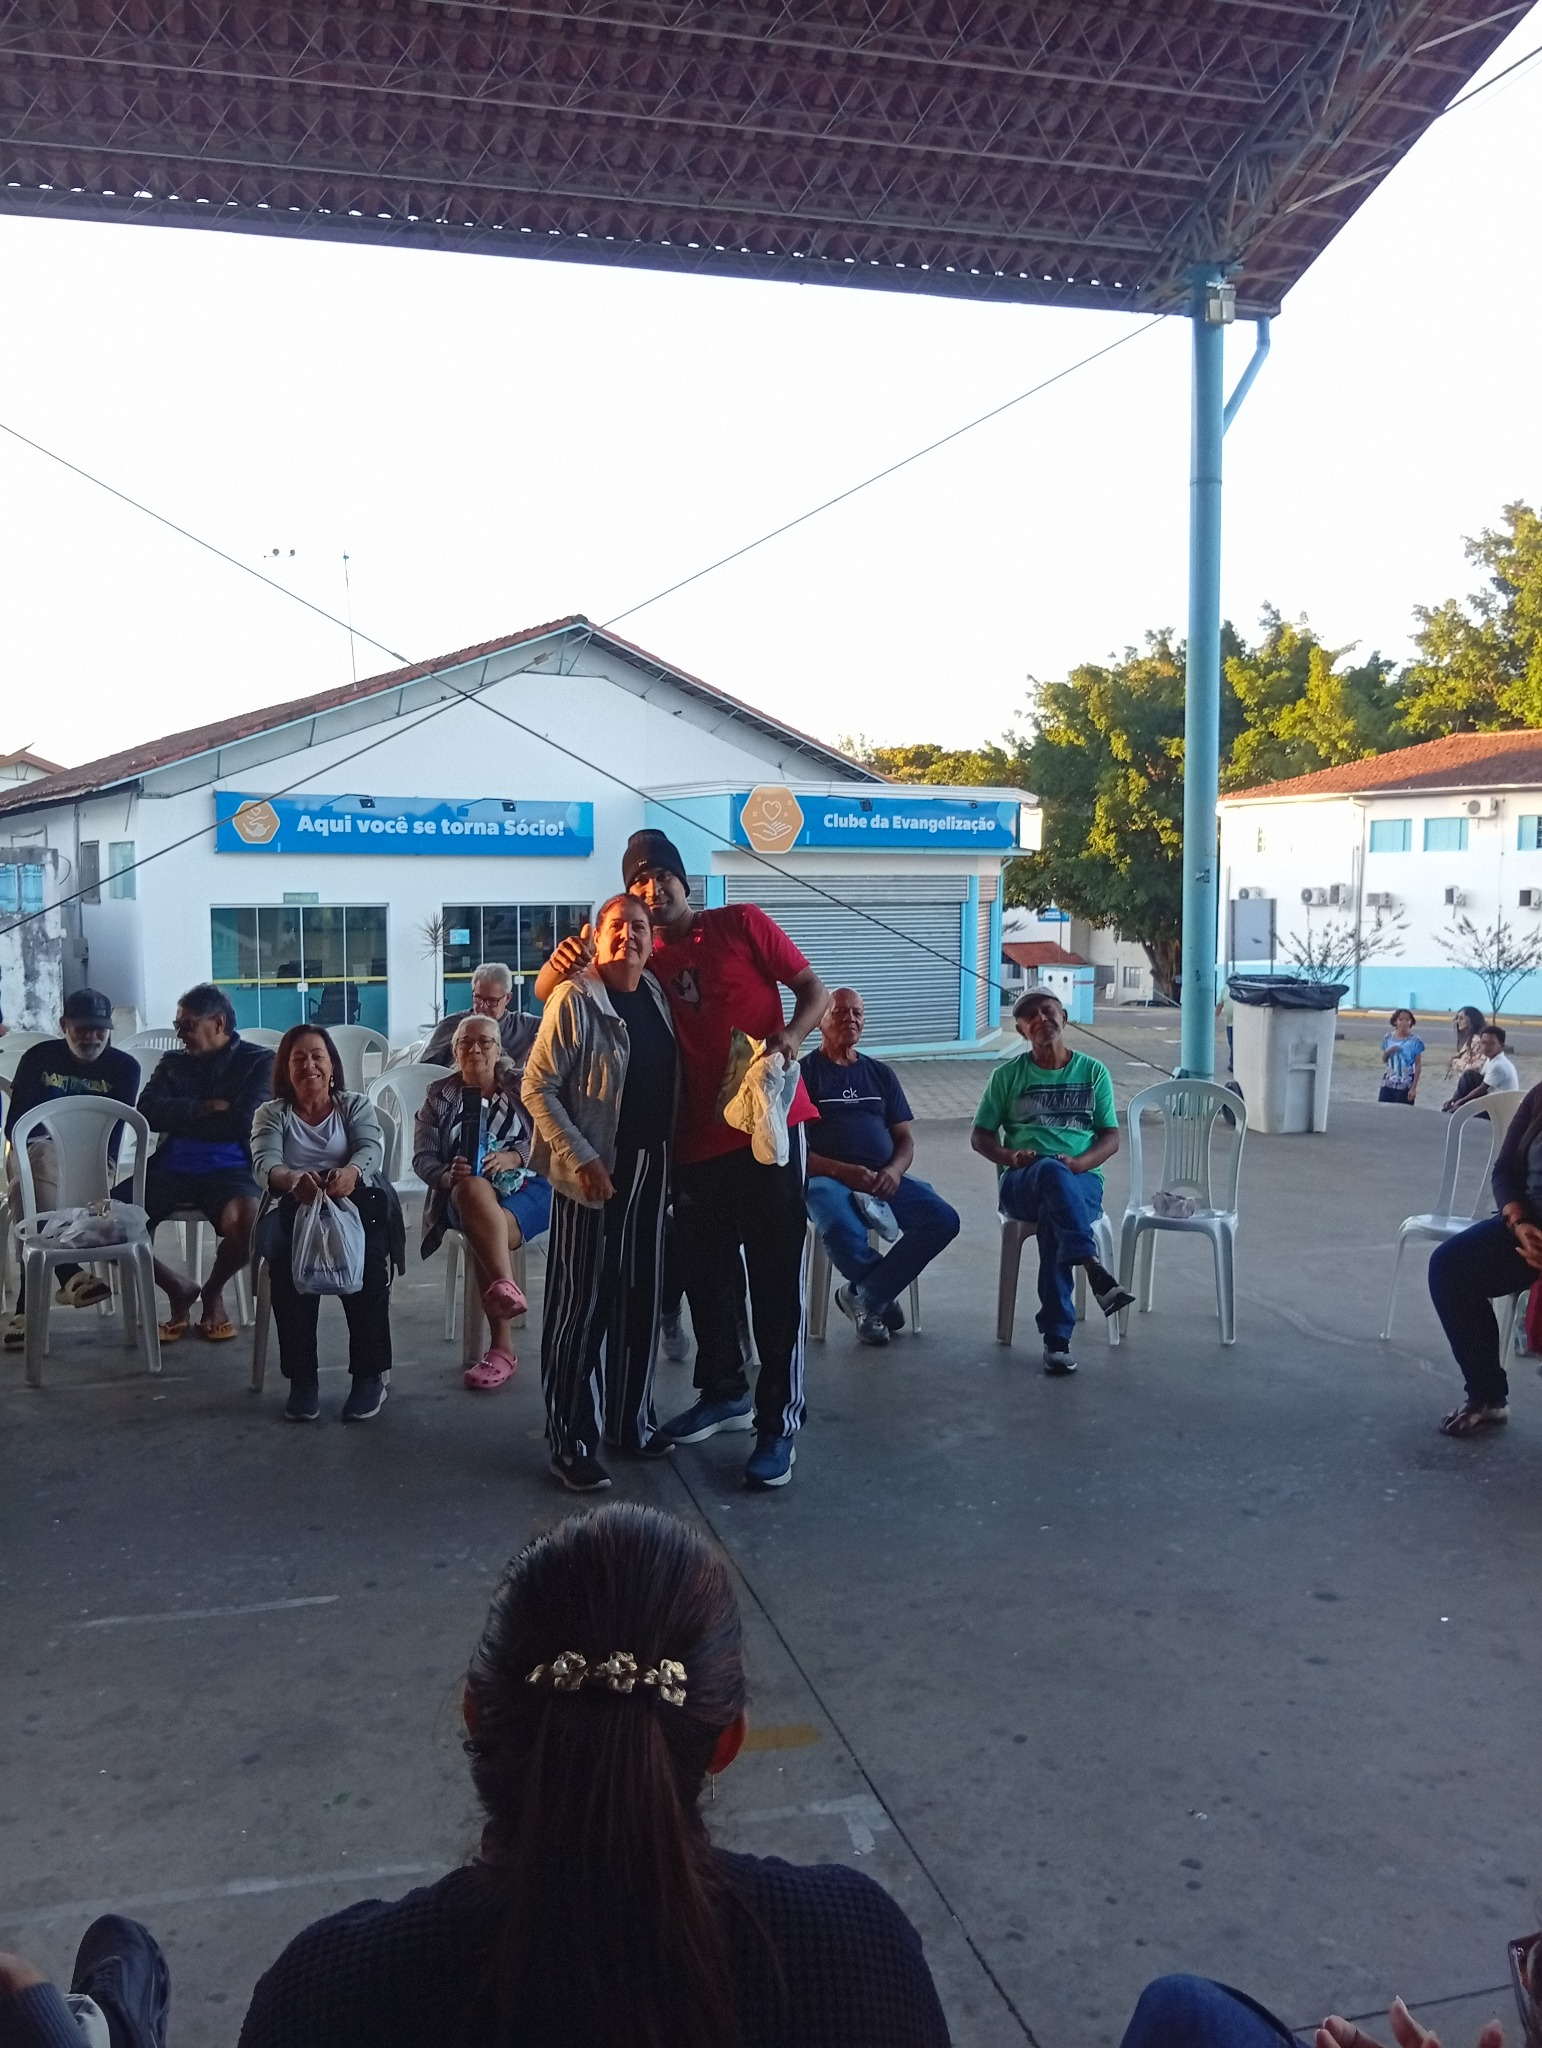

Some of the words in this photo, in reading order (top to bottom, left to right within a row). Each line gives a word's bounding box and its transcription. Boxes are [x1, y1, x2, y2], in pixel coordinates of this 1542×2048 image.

[297, 815, 352, 836] Aqui
[357, 816, 408, 834] você
[413, 821, 437, 834] se
[441, 820, 499, 835] torna
[503, 818, 565, 836] Sócio!
[823, 813, 868, 829] Clube
[870, 814, 890, 829] da
[892, 815, 996, 834] Evangelização
